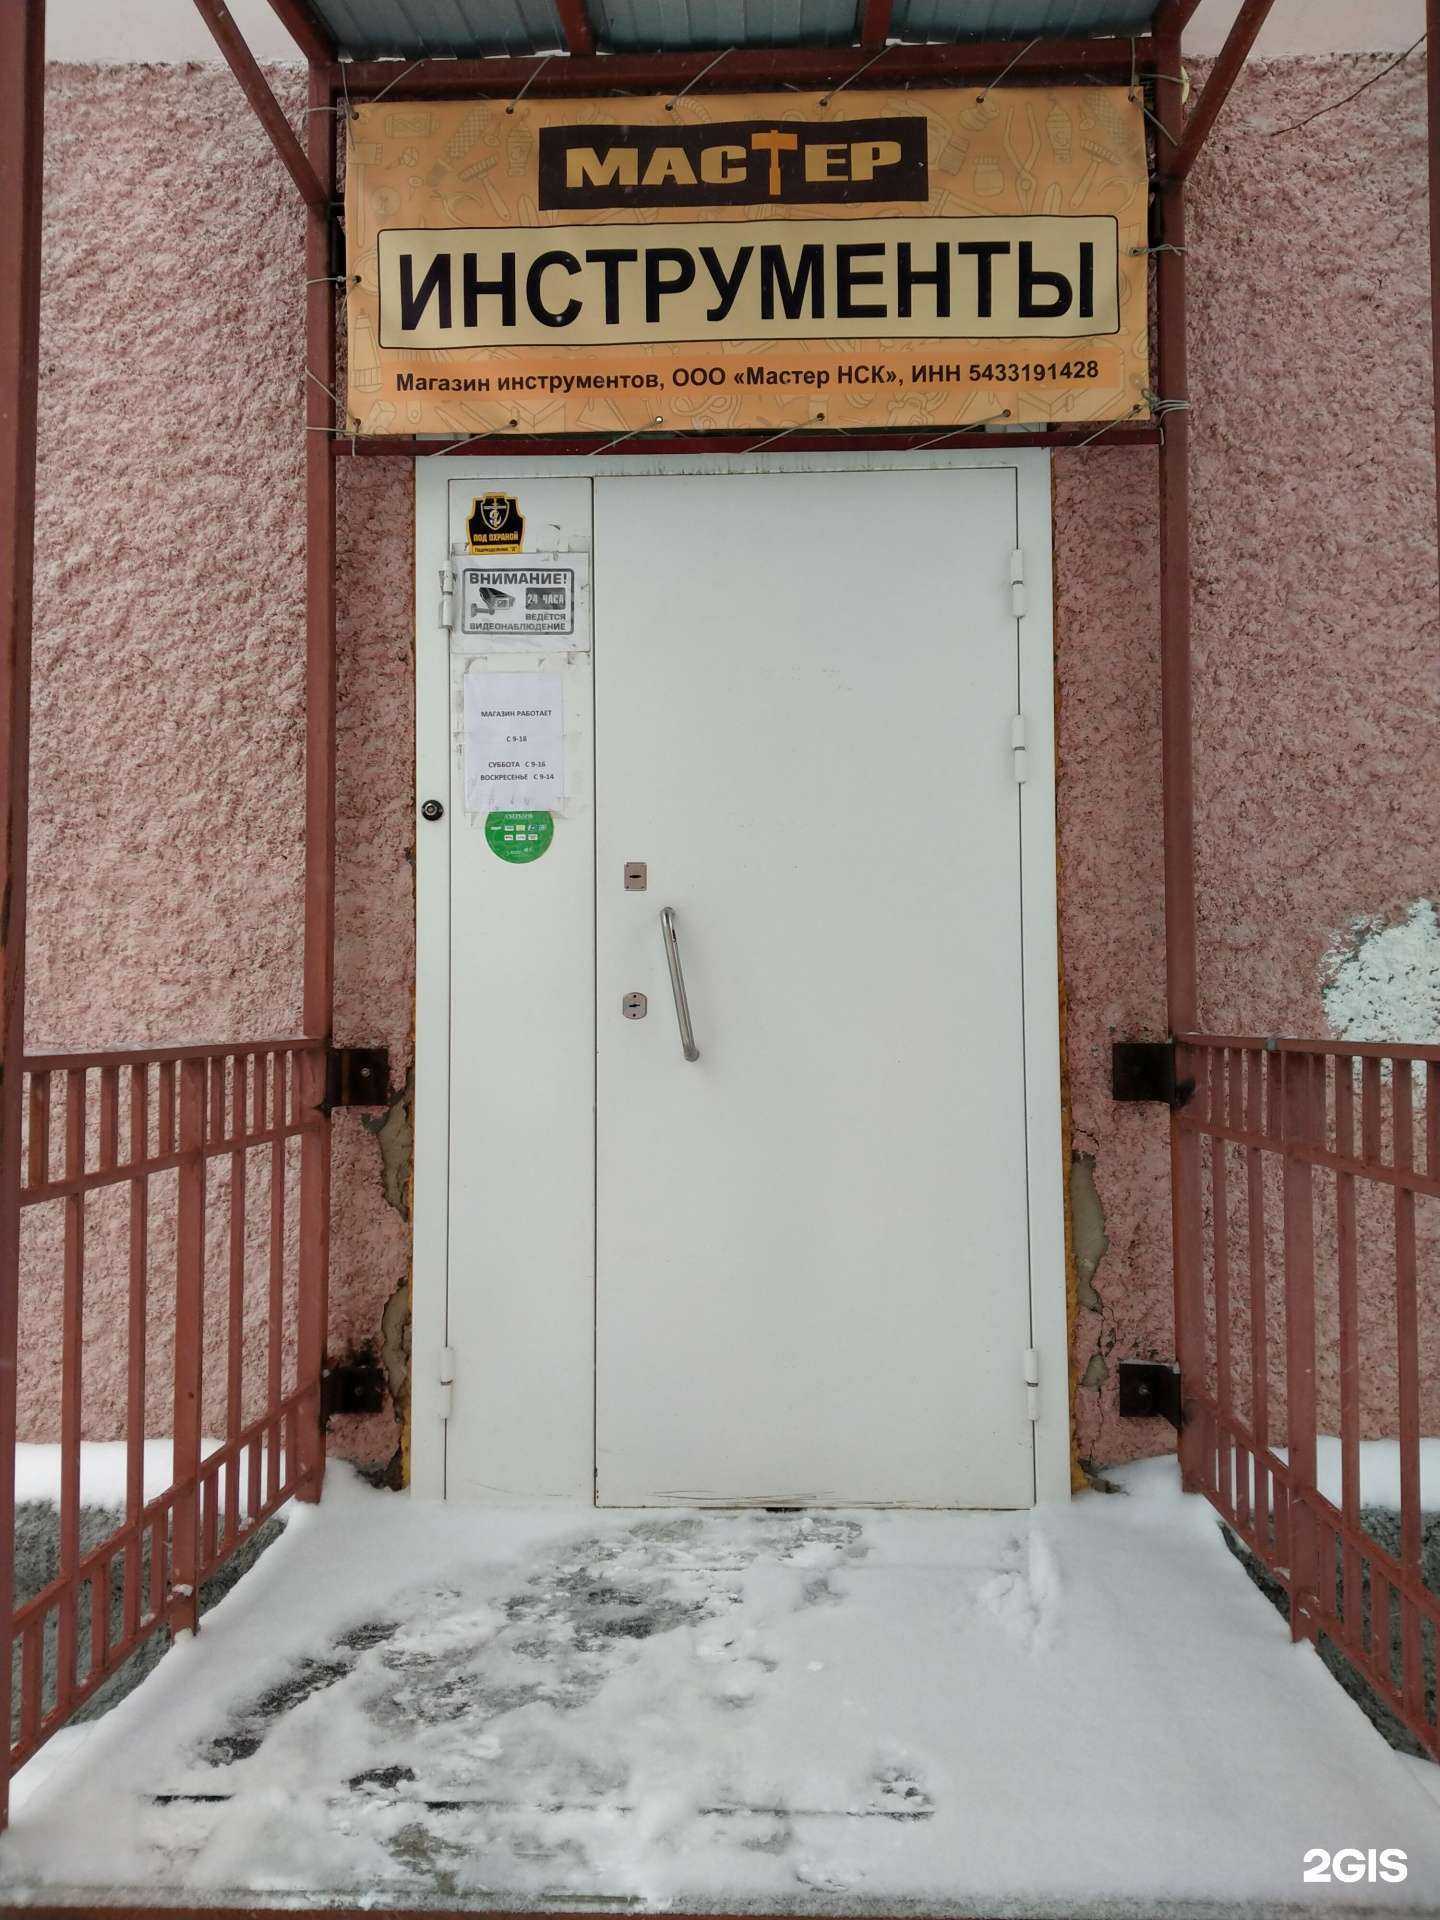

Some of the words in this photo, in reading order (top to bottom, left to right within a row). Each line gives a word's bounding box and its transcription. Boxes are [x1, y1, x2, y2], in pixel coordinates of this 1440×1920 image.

[566, 130, 902, 195] МАСТЕР
[400, 241, 1094, 331] ИНСТРУМЕНТЫ
[396, 373, 490, 392] Магазин
[498, 374, 665, 393] инструментов,
[672, 367, 726, 387] ООО
[734, 366, 830, 388] «Мастер
[837, 364, 904, 386] НСК»,
[912, 364, 961, 383] ИНН
[968, 360, 1099, 381] 5433191428
[470, 573, 567, 584] ВНИМАНИЕ!
[528, 595, 538, 604] 24
[543, 594, 564, 604] ЧАСА
[480, 710, 515, 718] МАГАЗИН
[516, 709, 552, 717] РАБОТАЕТ
[488, 761, 520, 769] СУББОТА
